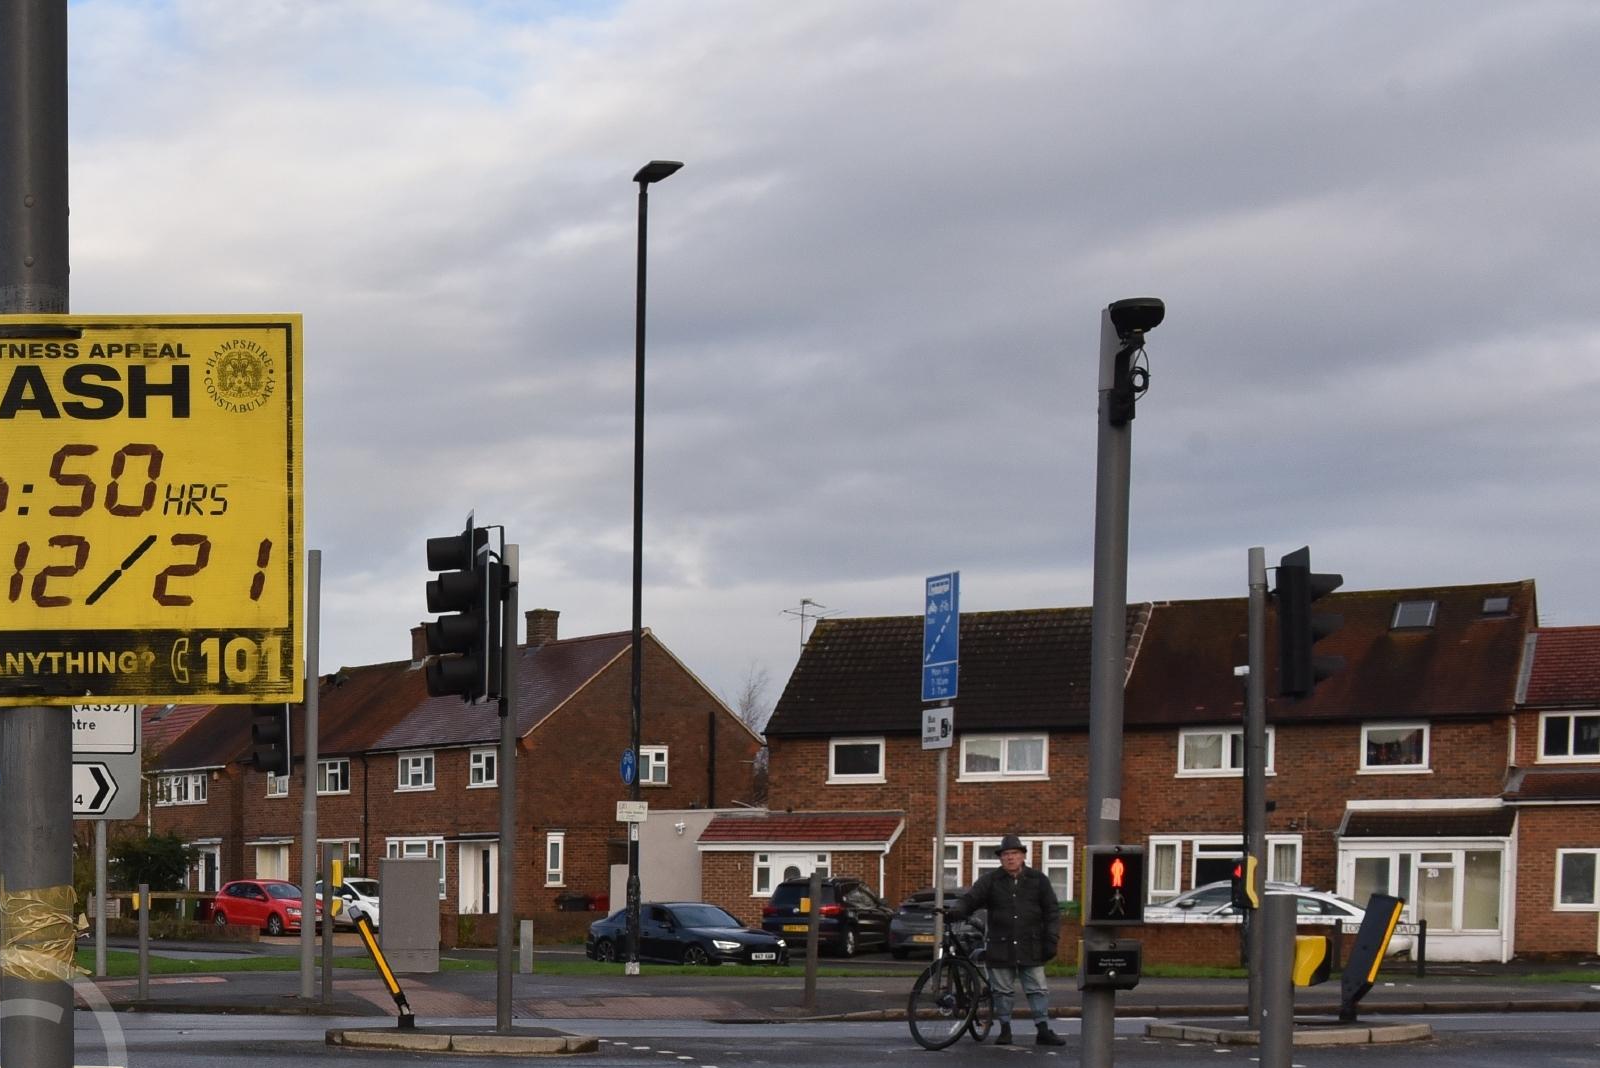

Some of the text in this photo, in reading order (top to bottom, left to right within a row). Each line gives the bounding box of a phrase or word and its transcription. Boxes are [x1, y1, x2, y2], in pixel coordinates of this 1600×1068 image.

[89, 342, 191, 360] APPEAL
[206, 339, 274, 368] HAMPSHIRE
[203, 376, 276, 413] CONSTABULARY
[163, 483, 229, 516] HRS
[200, 636, 282, 685] 101
[1427, 868, 1439, 877] 20
